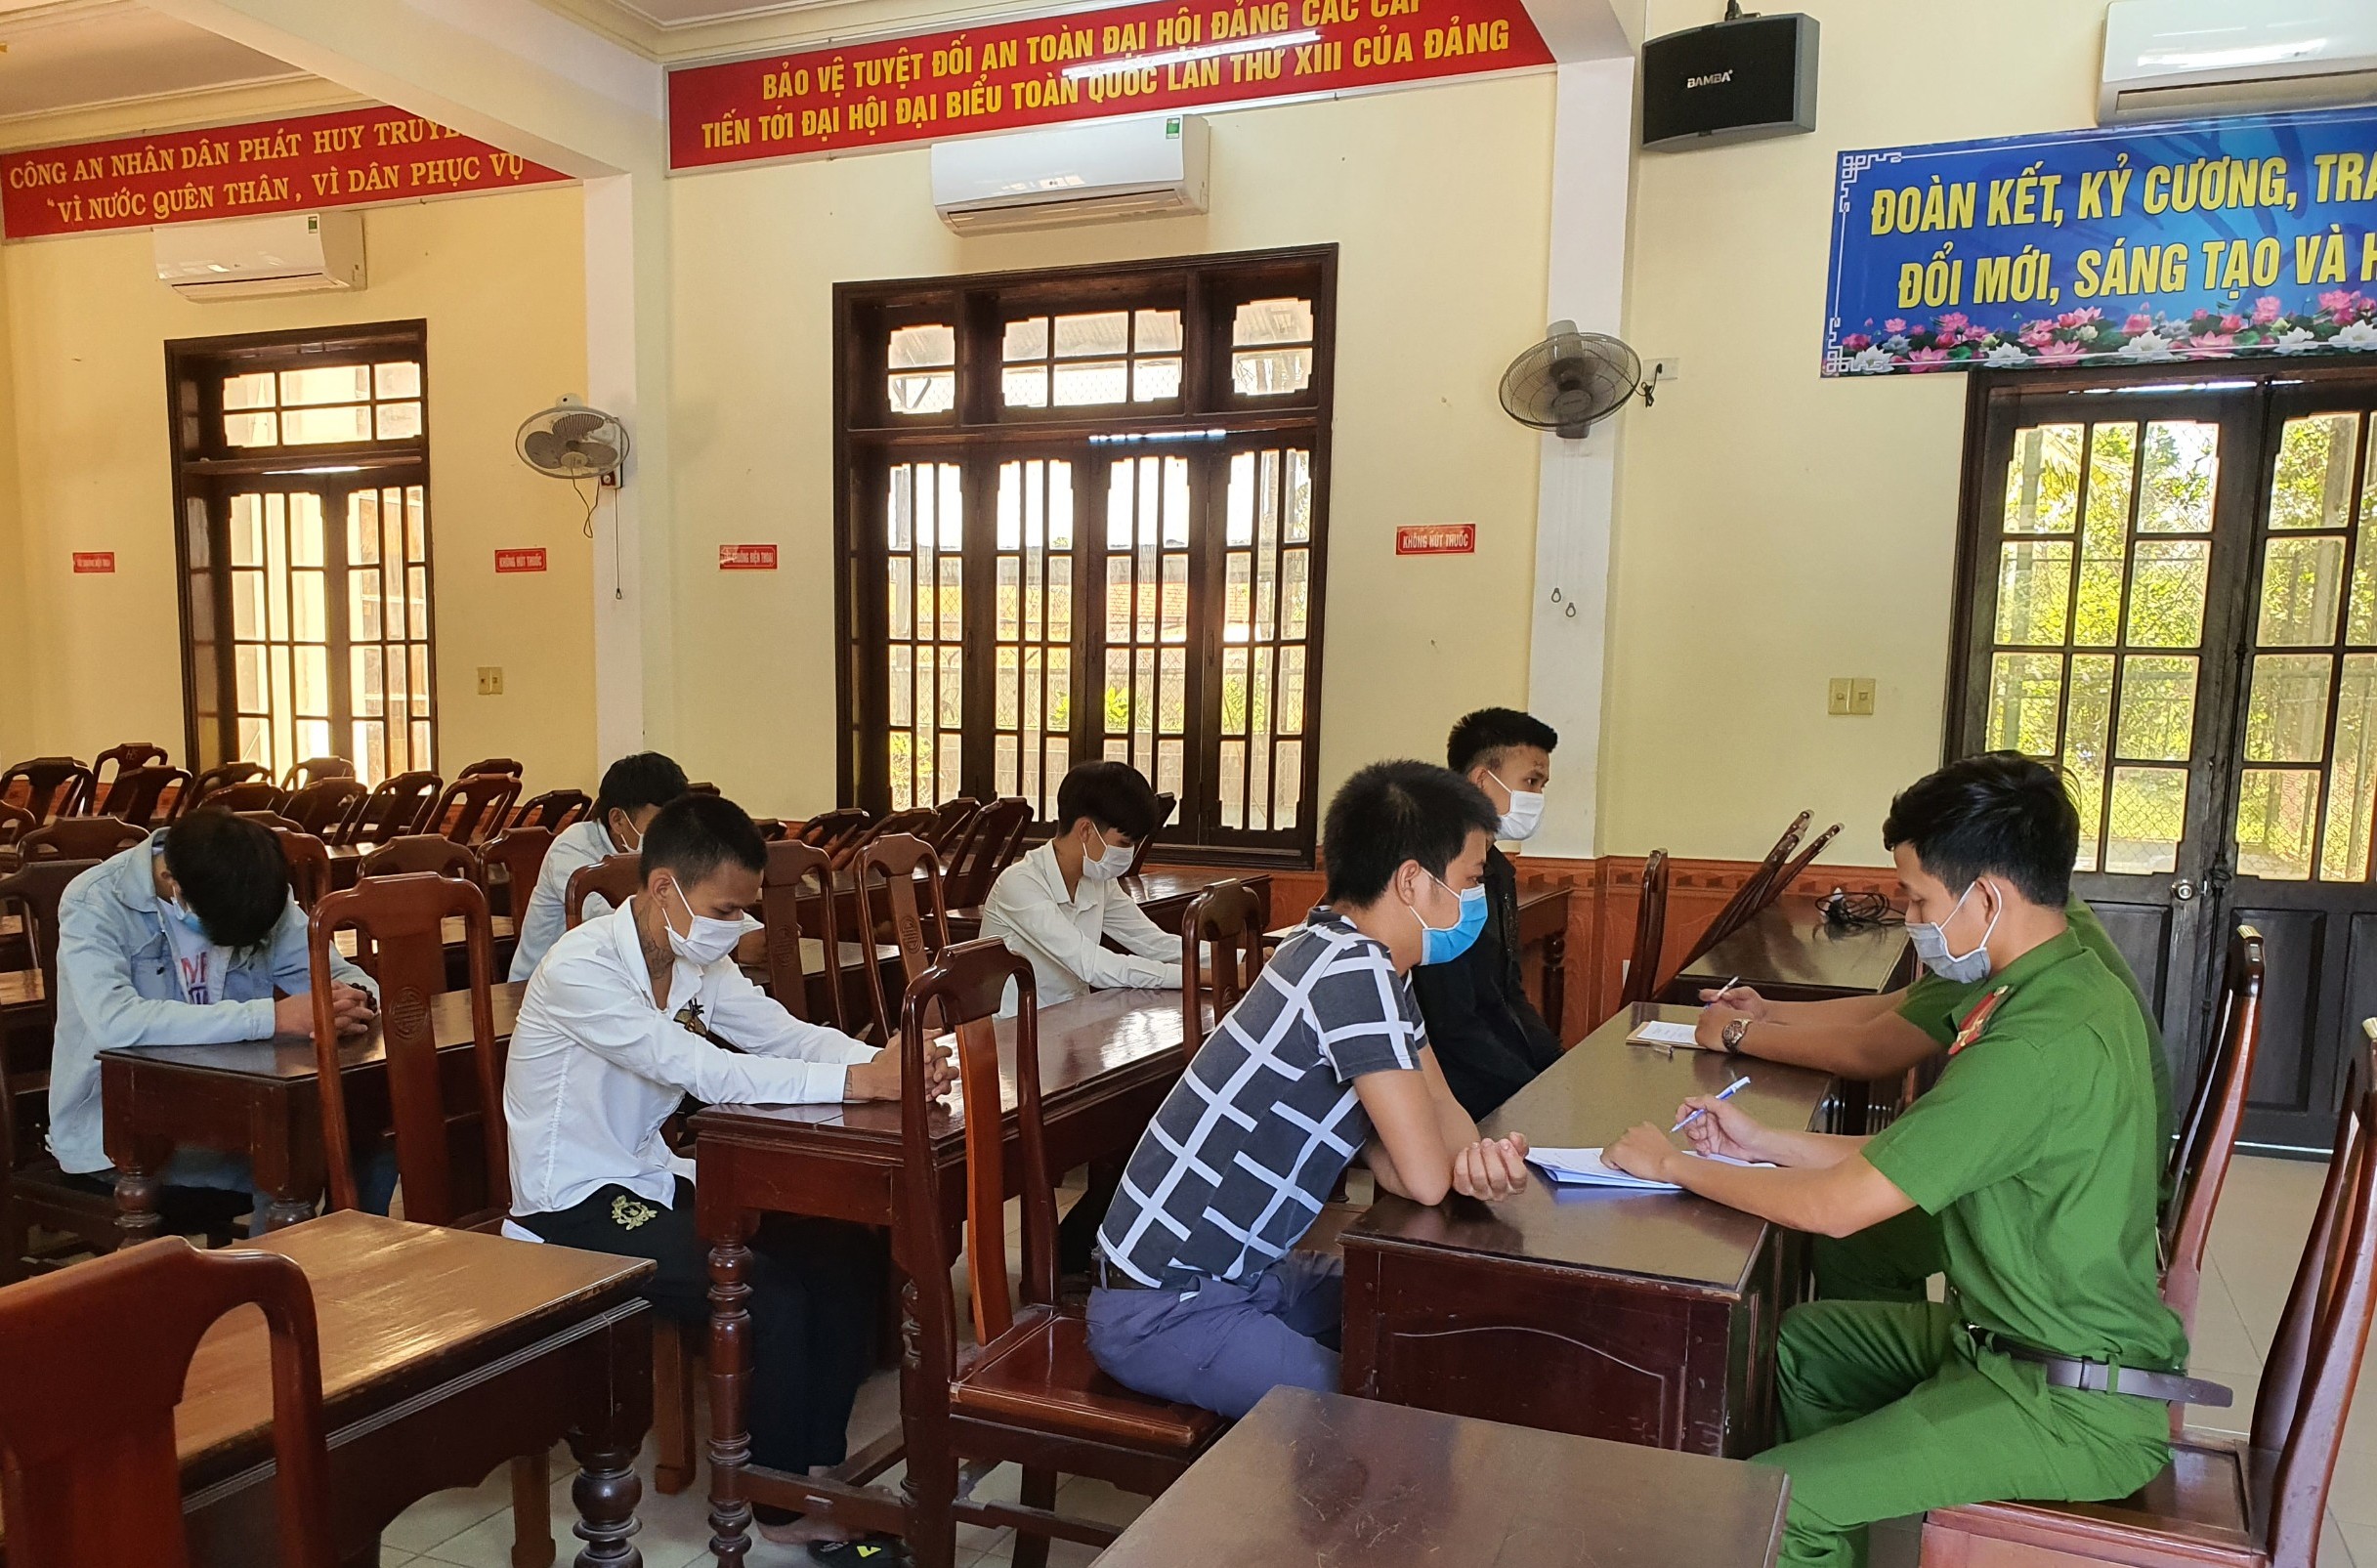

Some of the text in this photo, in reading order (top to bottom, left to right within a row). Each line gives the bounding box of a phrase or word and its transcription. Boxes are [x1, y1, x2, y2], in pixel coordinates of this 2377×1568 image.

[701, 107, 750, 148] TIẾN
[758, 105, 793, 142] TỚI
[801, 106, 840, 143] ĐẠI
[848, 95, 887, 136] HỘI
[896, 94, 937, 129] ĐẠI
[946, 73, 1002, 119] BIỂU
[1011, 72, 1079, 110] TOÀN
[1295, 41, 1342, 76] XIII
[1353, 24, 1414, 68] CỦA
[1423, 15, 1509, 60] ĐẢNG
[763, 61, 810, 101] BẢO
[817, 57, 845, 98] VỆ
[853, 47, 923, 90] TUYỆT
[931, 33, 972, 78] ĐỐI
[981, 39, 1017, 71] AN
[1026, 24, 1093, 64] TOÀN
[1102, 21, 1146, 60] ĐẠI
[1156, 7, 1201, 52] HỘI
[1210, 0, 1289, 40] ĐẢNG
[1686, 72, 1731, 88] BAMBA
[10, 160, 67, 190] CÔNG
[73, 157, 104, 182] AN
[111, 145, 175, 178] NHÂN
[181, 139, 231, 169] DÂN
[238, 128, 302, 162] PHÁT
[313, 125, 365, 154] HUY
[88, 187, 147, 221] NƯỚC
[152, 182, 215, 220] QUÊN
[311, 165, 340, 196] VÌ
[348, 161, 401, 193] DÂN
[410, 156, 481, 188] PHỤC
[489, 152, 524, 181] VỤ
[1870, 174, 1978, 235] ĐOÀN
[1986, 160, 2064, 229] KẾT,
[2077, 152, 2133, 220] KỶ
[2143, 155, 2298, 216] CƯƠNG,
[1897, 241, 1963, 309] ĐỔI
[1973, 244, 2060, 306] MỚI,
[2073, 237, 2188, 299] SÁNG
[2201, 236, 2281, 300] TẠO
[2295, 223, 2347, 285] VÀ
[1403, 530, 1469, 548] KHÔNG HÚT THUỐC
